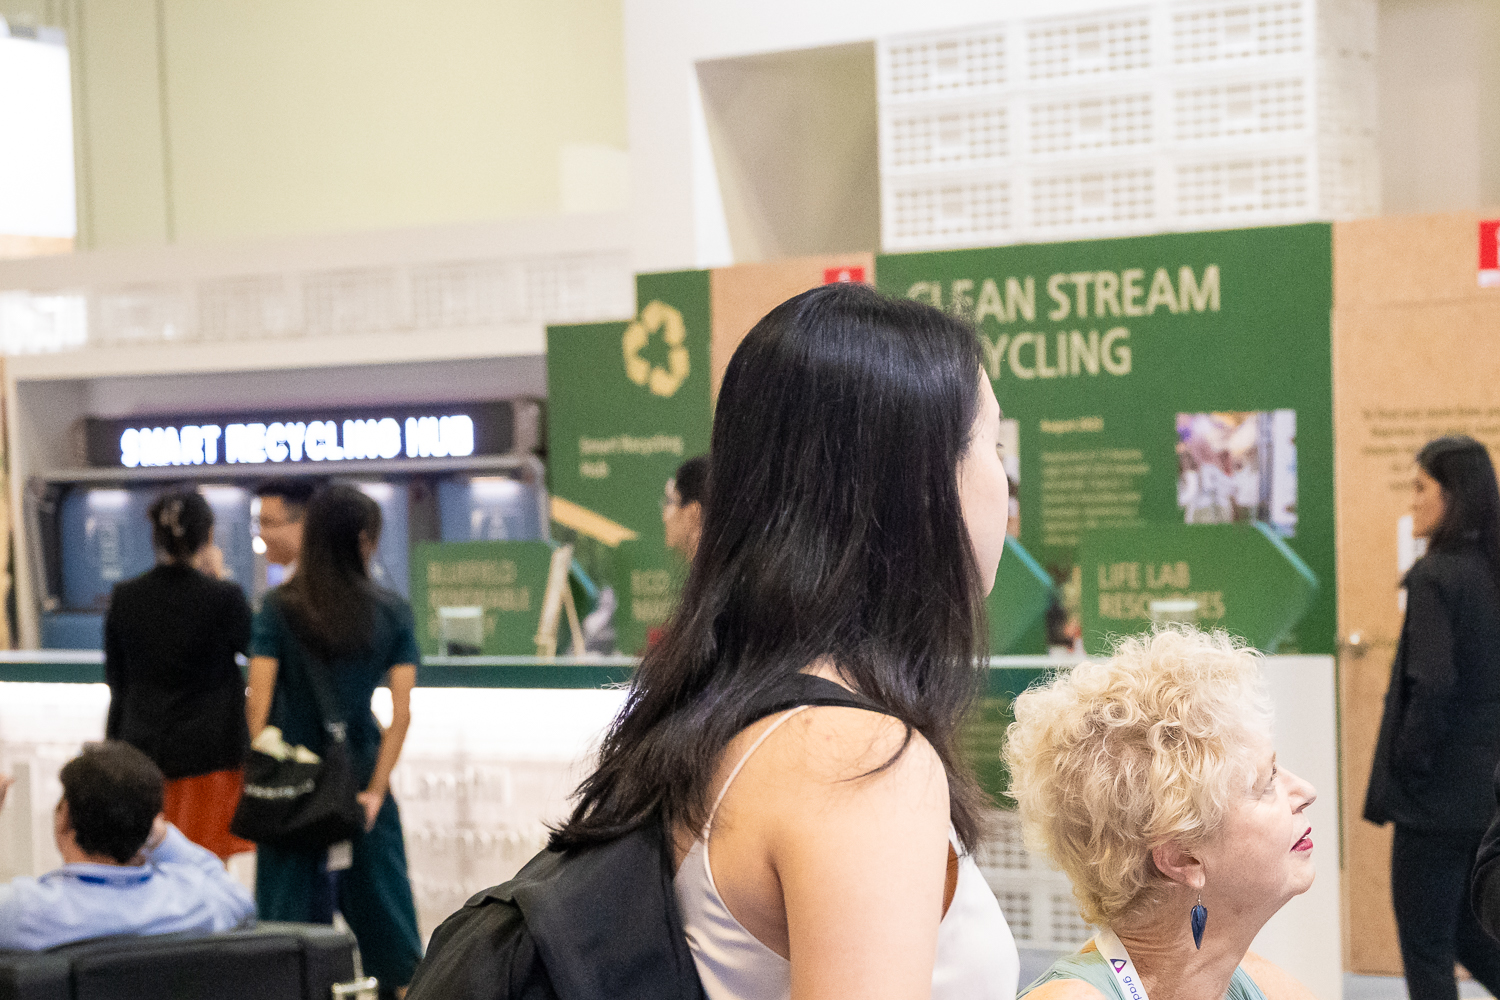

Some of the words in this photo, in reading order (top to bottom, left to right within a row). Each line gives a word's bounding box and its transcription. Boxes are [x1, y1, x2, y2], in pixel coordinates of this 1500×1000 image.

[1047, 264, 1221, 321] STREAM
[120, 425, 222, 467] SMART
[225, 417, 401, 463] RECYCLING
[405, 415, 474, 457] HUB
[1098, 562, 1140, 589] LIFE
[1146, 561, 1190, 589] LAB
[1099, 590, 1226, 620] RESOES
